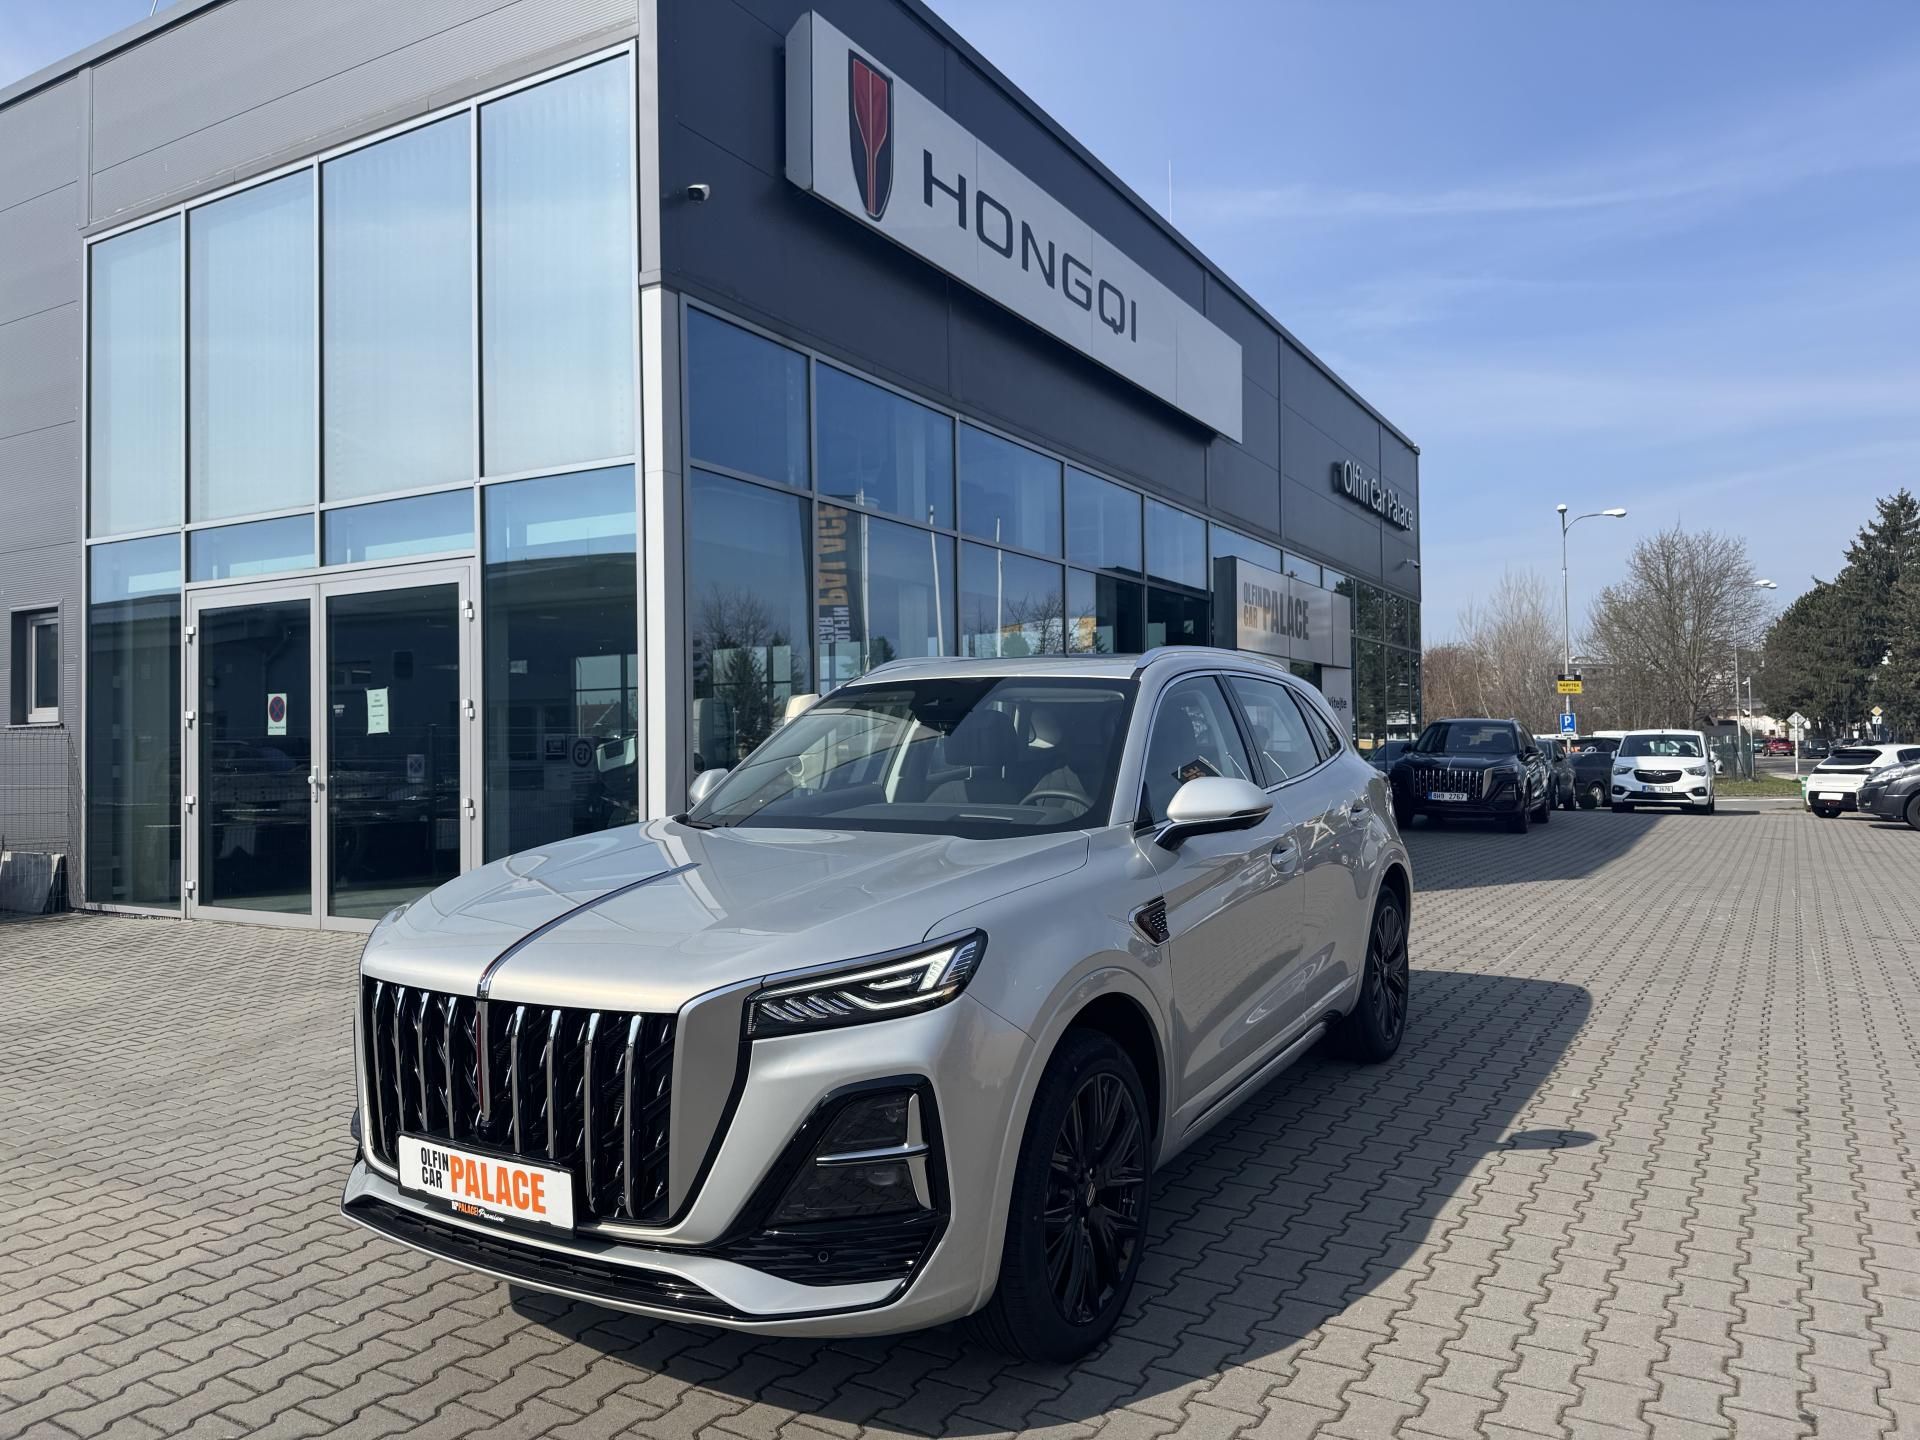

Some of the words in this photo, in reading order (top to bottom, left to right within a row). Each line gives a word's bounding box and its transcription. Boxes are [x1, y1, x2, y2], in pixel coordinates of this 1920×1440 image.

[923, 149, 1137, 344] HONGQI
[1344, 460, 1369, 505] Olfin
[1371, 478, 1386, 514] Car
[1387, 488, 1413, 531] Palace
[1243, 582, 1263, 608] OLFIN
[1243, 605, 1258, 629] CAR
[1263, 587, 1309, 641] PALACE
[1564, 715, 1571, 726] P
[421, 1147, 449, 1172] OLFIN
[422, 1167, 443, 1189] CAR
[449, 1154, 547, 1215] PALACE
